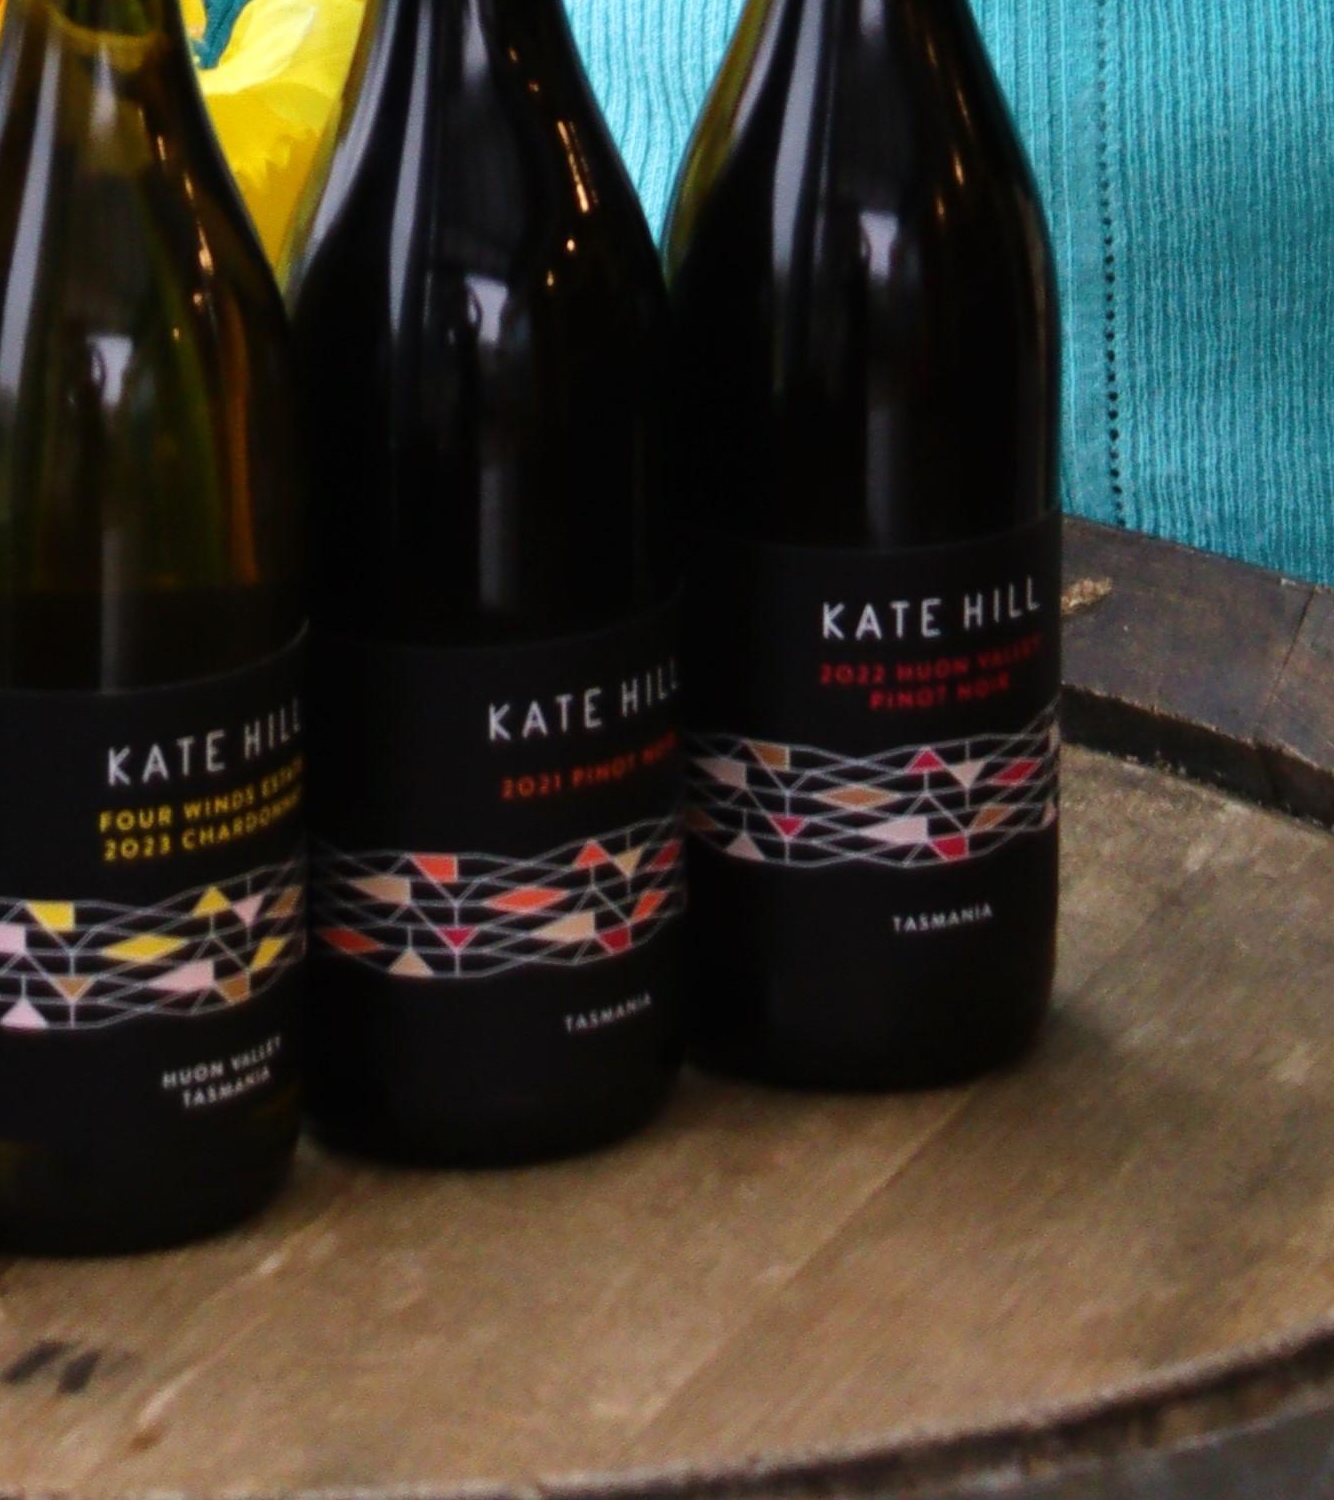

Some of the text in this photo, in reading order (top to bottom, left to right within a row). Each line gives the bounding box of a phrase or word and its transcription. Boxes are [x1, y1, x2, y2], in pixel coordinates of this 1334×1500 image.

[821, 574, 1041, 641] KATE HILL
[818, 660, 886, 686] 2022
[895, 655, 971, 683] HUON
[868, 670, 1010, 711] PINOT NOIR
[487, 657, 680, 742] KATE HILL
[107, 696, 301, 788] KATE HILL
[98, 803, 173, 834] FOUR
[181, 783, 257, 821] WINDS
[179, 783, 305, 850] CHARDONN
[892, 902, 994, 934] TASMANIA
[564, 992, 652, 1033] TASMANIA
[161, 1033, 282, 1089] HUON VALLEY
[182, 1065, 271, 1108] TASMANIA
